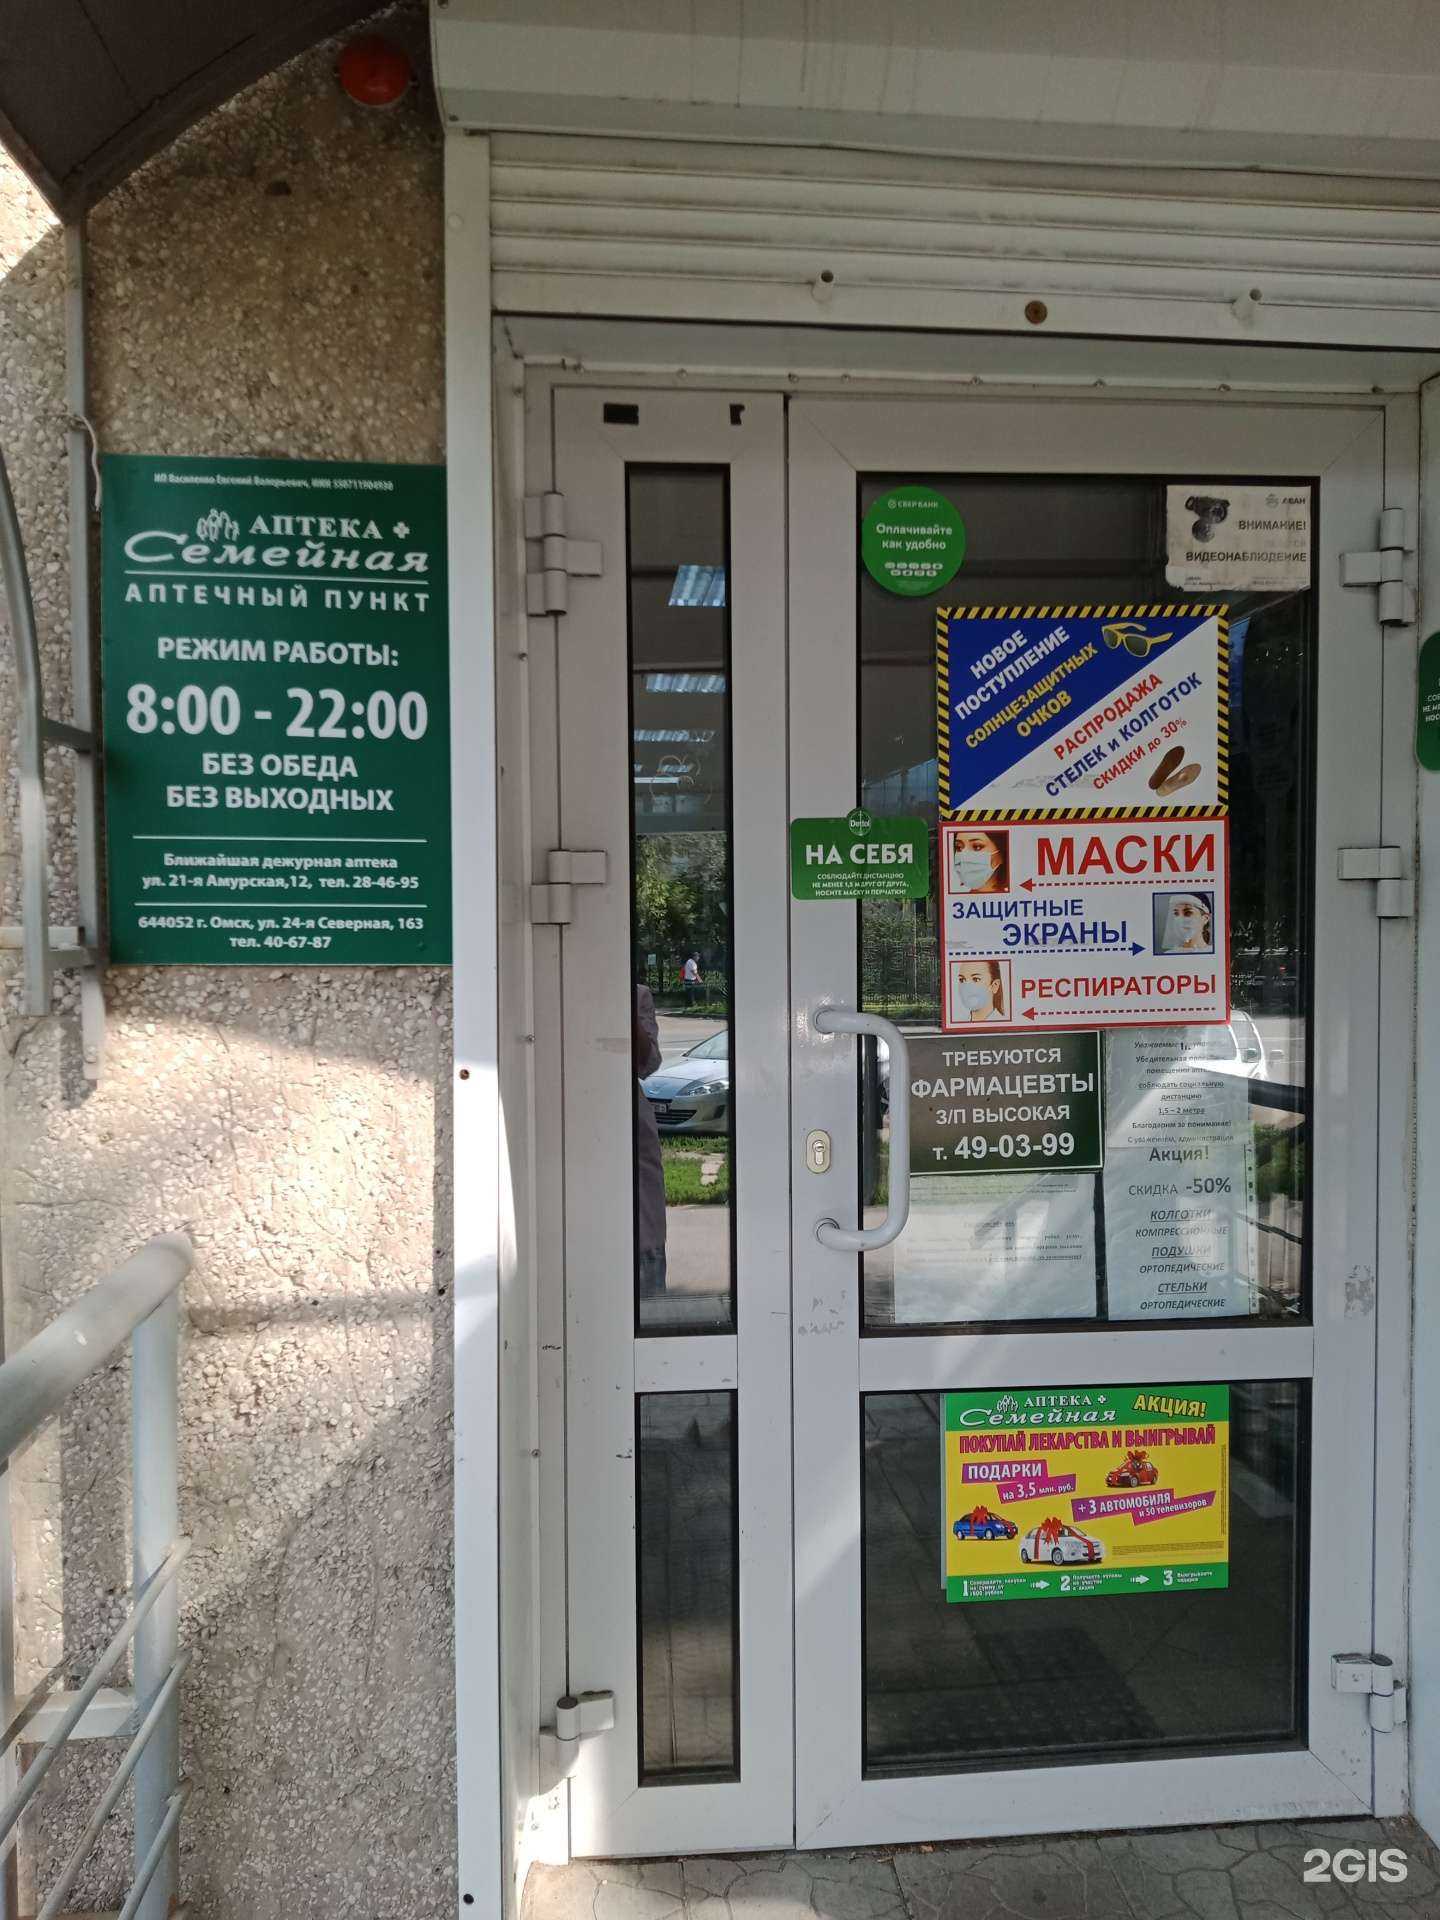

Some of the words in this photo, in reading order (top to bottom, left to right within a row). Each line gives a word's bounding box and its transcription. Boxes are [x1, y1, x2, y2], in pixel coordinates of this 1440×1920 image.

[249, 515, 384, 540] АПТЕКА
[876, 522, 953, 535] Оплачивайте
[1238, 519, 1306, 531] ВНИМАНИЕ!
[124, 531, 429, 573] Семейная
[881, 539, 902, 549] как
[905, 538, 947, 552] удобно
[1185, 551, 1307, 563] ВИДЕОНАБЛЮДЕНИЕ
[125, 583, 308, 608] АПТЕЧНЫЙ
[324, 589, 430, 612] ПУНКТ
[157, 637, 266, 662] РЕЖИМ
[274, 640, 400, 667] РАБОТЫ:
[969, 629, 1028, 680] НОВОЕ
[954, 626, 1071, 720] ПОСТУПЛЕНИЕ
[965, 642, 1099, 749] СОЛНЦЕЗАЩИТНЫХ
[126, 683, 241, 735] 8:00
[254, 708, 272, 720] -
[286, 688, 428, 741] 22:00
[1016, 690, 1073, 738] ОЧКОВ
[1053, 673, 1164, 761] РАСПРОДАЖА
[1045, 744, 1108, 797] СТЕЛЕК
[1107, 740, 1120, 751] и
[1119, 671, 1203, 742] КОЛГОТОК
[1092, 745, 1146, 791] СКИДКИ
[1147, 737, 1162, 753] до
[1160, 718, 1188, 740] 30%
[202, 753, 254, 775] БЕЗ
[260, 755, 359, 781] ОБЕДА
[166, 786, 219, 808] БЕЗ
[225, 787, 394, 814] ВЫХОДНЫХ
[164, 853, 259, 868] Ближайшая
[262, 857, 341, 871] дежурная
[345, 858, 397, 869] аптека
[805, 844, 843, 865] НА
[849, 843, 913, 864] СЕБЯ
[1036, 834, 1215, 876] МАСКИ
[142, 876, 165, 890] ул.
[168, 876, 203, 887] 21-я
[319, 877, 350, 889] тел.
[352, 876, 419, 889] 28-46-95
[952, 899, 1084, 921] ЗАЩИТНЫЕ
[138, 916, 194, 929] 644052
[196, 919, 207, 929] г.
[210, 917, 254, 931] Омск,
[257, 919, 280, 932] ул.
[283, 918, 316, 930] 24-я
[317, 917, 394, 931] Северная,
[397, 917, 424, 930] 163
[1002, 921, 1127, 946] ЭКРАНЫ
[230, 937, 261, 949] тел.
[263, 936, 332, 949] 40-67-87
[1021, 974, 1216, 999] РЕСПИРАТОРЫ
[942, 1047, 1062, 1067] ТРЕБУЮТСЯ
[911, 1072, 1094, 1099] ФАРМАЦЕВТЫ
[935, 1108, 966, 1125] З/П
[972, 1104, 1071, 1124] ВЫСОКАЯ
[932, 1146, 948, 1161] т.
[954, 1132, 1075, 1160] 49-03-99
[1149, 1145, 1209, 1164] Акция!
[1128, 1184, 1178, 1197] СКИДКА
[1185, 1177, 1232, 1194] -50%
[1150, 1208, 1213, 1221] КОЛГОТКИ
[1139, 1262, 1225, 1274] ОРТОПЕДИЧЕСКИЕ
[1157, 1281, 1208, 1293] СТЕЛЬКИ
[1140, 1299, 1226, 1311] ОРТОПЕДИЧЕСКИЕ
[959, 1408, 1117, 1426] Семейная
[1024, 1394, 1091, 1407] АПТЕКА
[1133, 1394, 1207, 1418] АКЦИЯ!
[959, 1430, 1026, 1453] ПОКУПАЙ
[1028, 1430, 1109, 1452] ЛЕКАРСТВА
[1112, 1430, 1121, 1449] И
[1125, 1424, 1216, 1448] ВЫИГРЫВАЙ
[968, 1463, 1042, 1480] ПОДАРКИ
[1002, 1491, 1015, 1501] на
[1016, 1482, 1036, 1498] 3,5
[1039, 1486, 1057, 1494] млн.
[1058, 1483, 1074, 1493] руб.
[1089, 1499, 1097, 1514] 3
[1100, 1492, 1171, 1513] АВТОМОБИЛЯ
[1145, 1507, 1155, 1516] 50
[1156, 1499, 1208, 1515] телевизоров
[963, 1580, 969, 1597] 1
[1060, 1575, 1071, 1591] 2
[1163, 1569, 1173, 1586] 3
